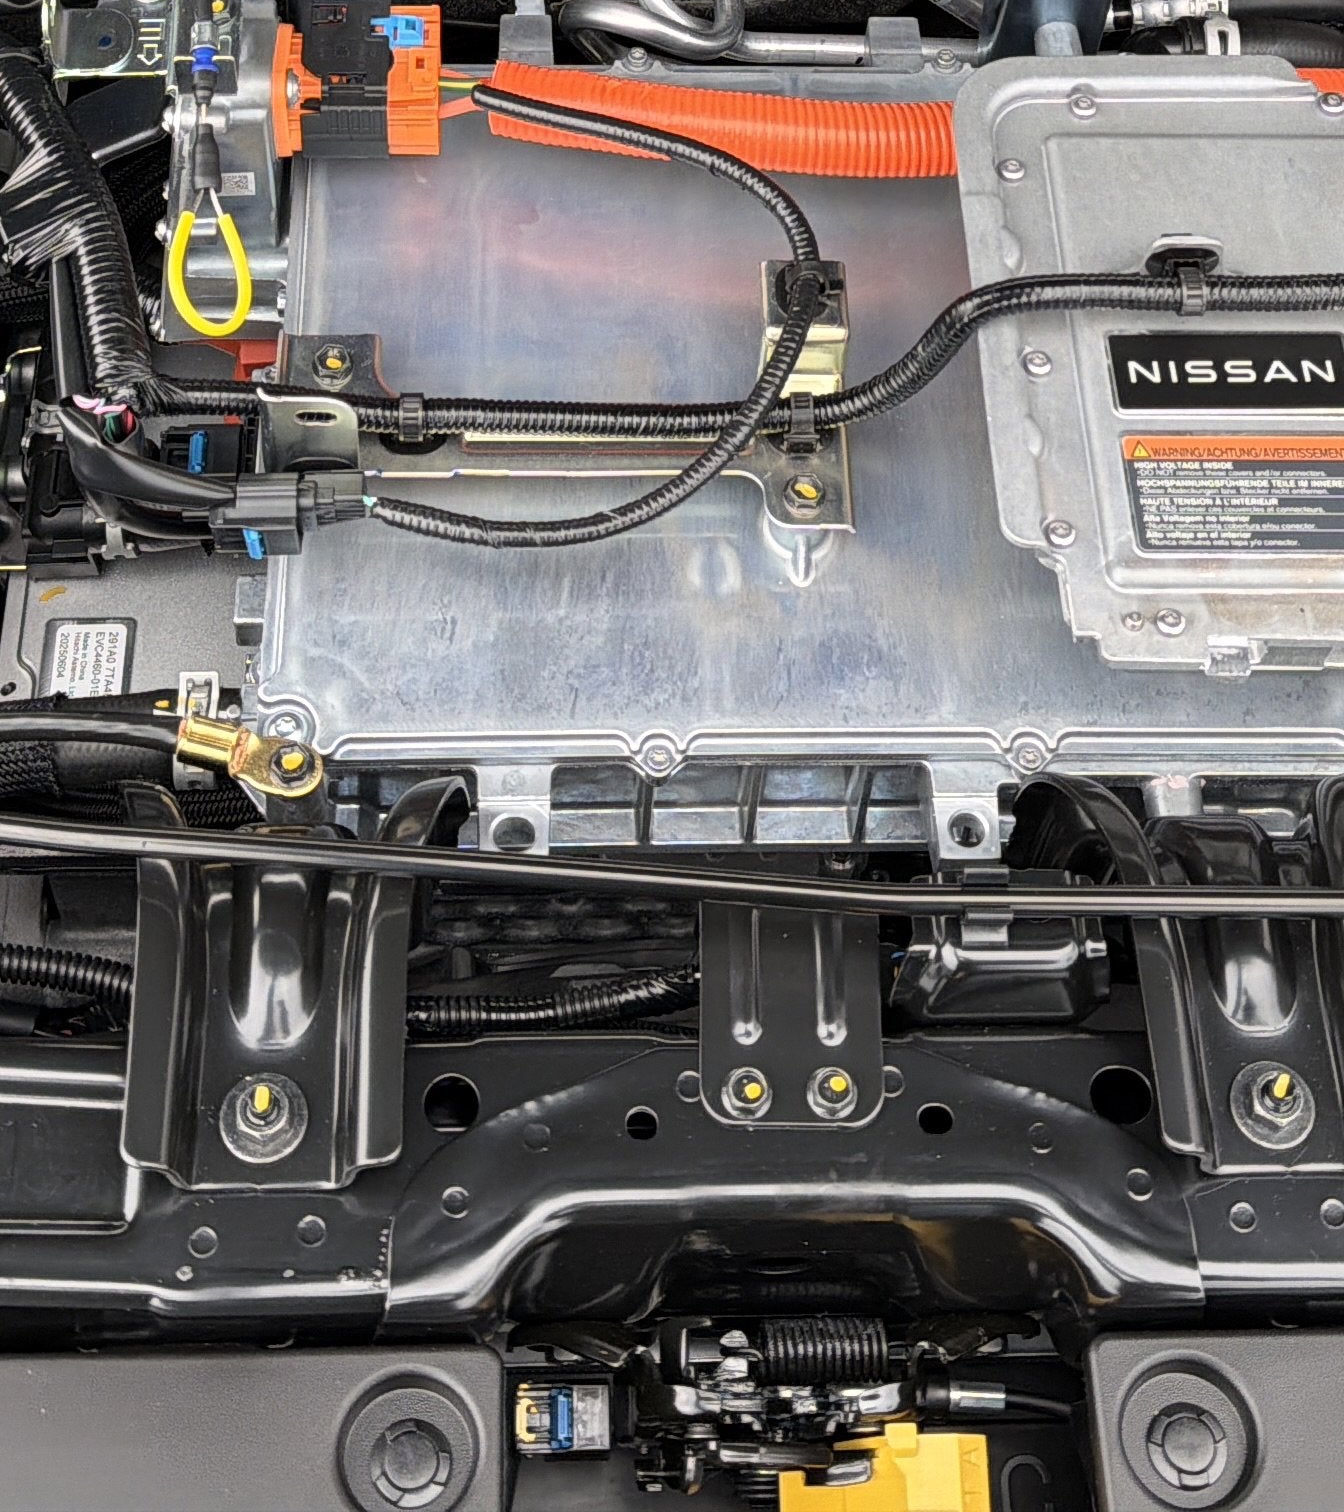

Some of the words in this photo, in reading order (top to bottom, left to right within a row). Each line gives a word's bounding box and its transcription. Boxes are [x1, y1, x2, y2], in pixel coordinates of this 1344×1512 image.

[1128, 360, 1335, 383] NISSAN
[1298, 480, 1308, 488] IM
[73, 632, 81, 655] Hitachi
[81, 632, 90, 651] Made
[106, 632, 119, 663] 291A0
[56, 633, 70, 678] 20250604
[79, 660, 87, 681] China
